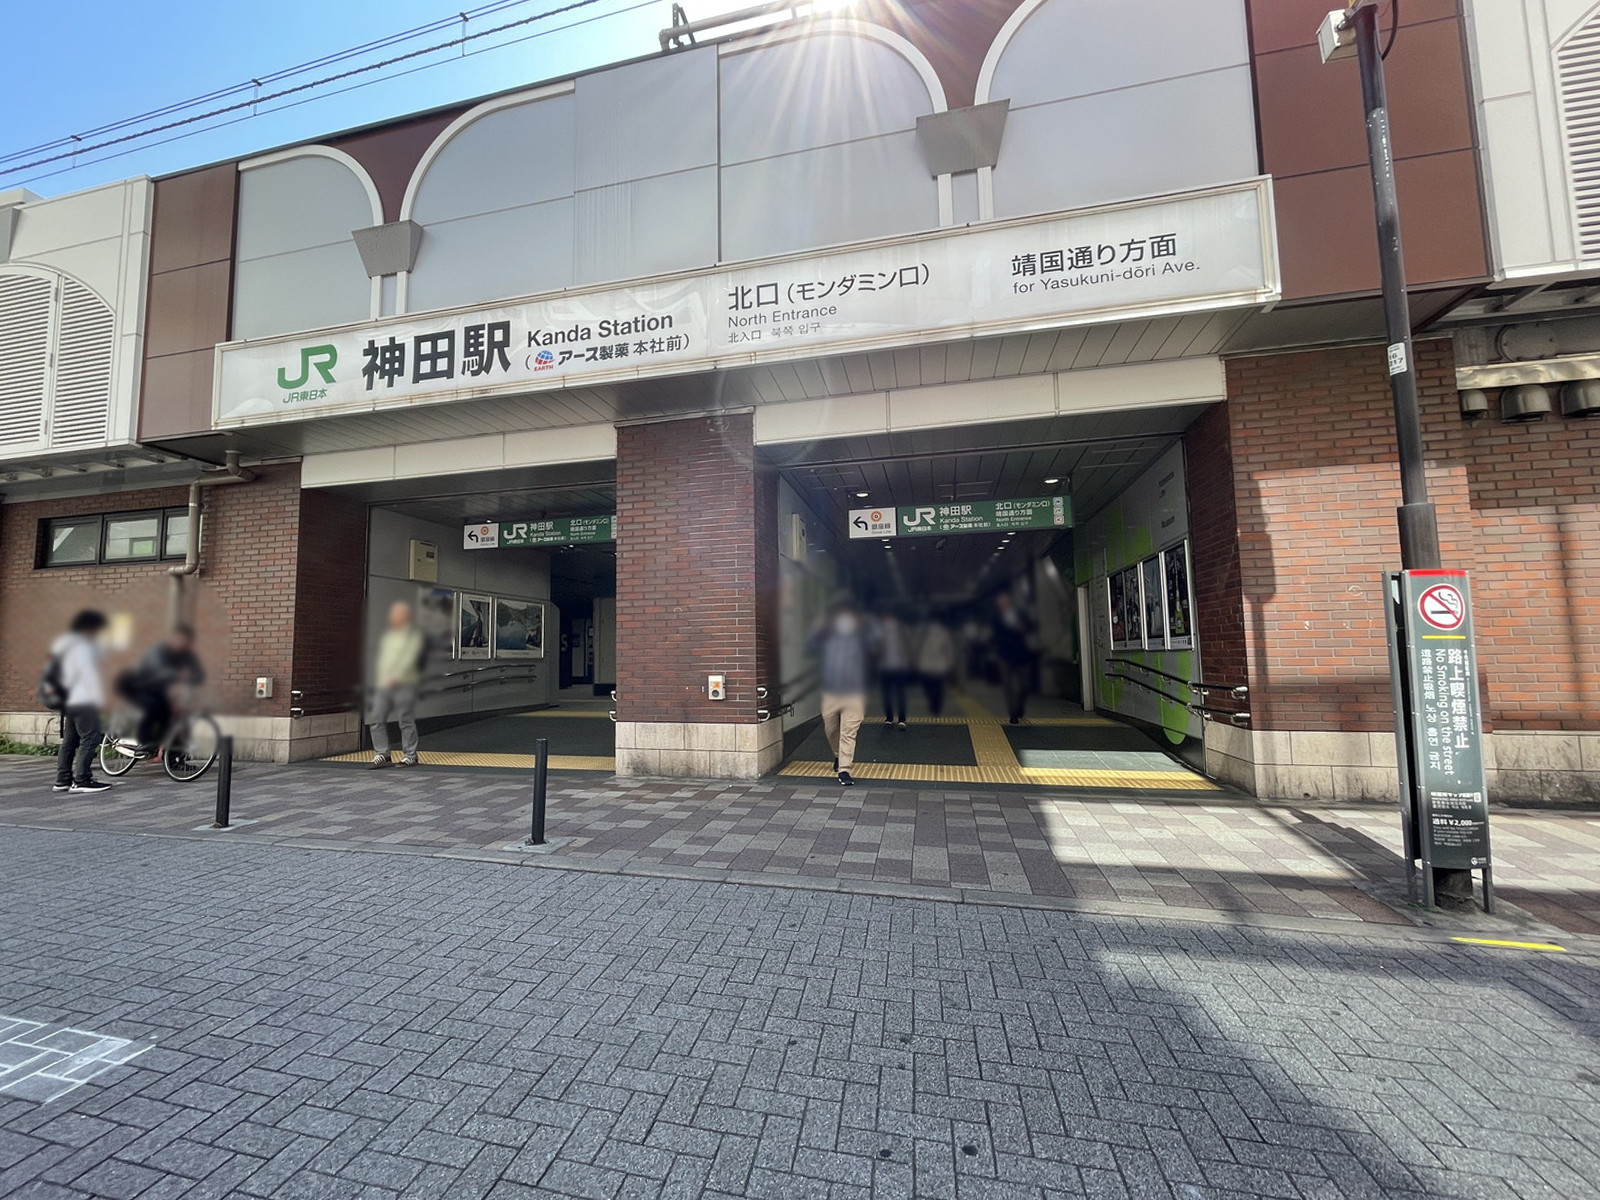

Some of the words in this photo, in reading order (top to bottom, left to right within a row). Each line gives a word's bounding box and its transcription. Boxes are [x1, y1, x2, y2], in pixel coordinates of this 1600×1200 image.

[1011, 233, 1177, 277] 靖国通り方面
[1013, 281, 1036, 294] for
[1040, 264, 1156, 290] Yasukuni-dōri
[1162, 261, 1201, 275] Ave.
[728, 313, 767, 328] North
[772, 305, 838, 323] Entrance
[526, 324, 592, 348] Kanda
[598, 314, 674, 339] Station
[728, 329, 762, 344] 北入口
[362, 320, 512, 391] 神田駅
[277, 344, 338, 390] JR
[282, 388, 328, 404] JR東日本
[903, 507, 936, 526] JR
[939, 505, 972, 517] 神田駅
[503, 523, 528, 540] JR
[529, 520, 554, 531] 神田駅
[1435, 649, 1446, 663] No
[1436, 665, 1450, 708] Smoking
[1447, 648, 1470, 749] 路上喫煙禁止
[1440, 709, 1450, 724] on
[1441, 726, 1453, 744] the
[1442, 745, 1455, 776] street
